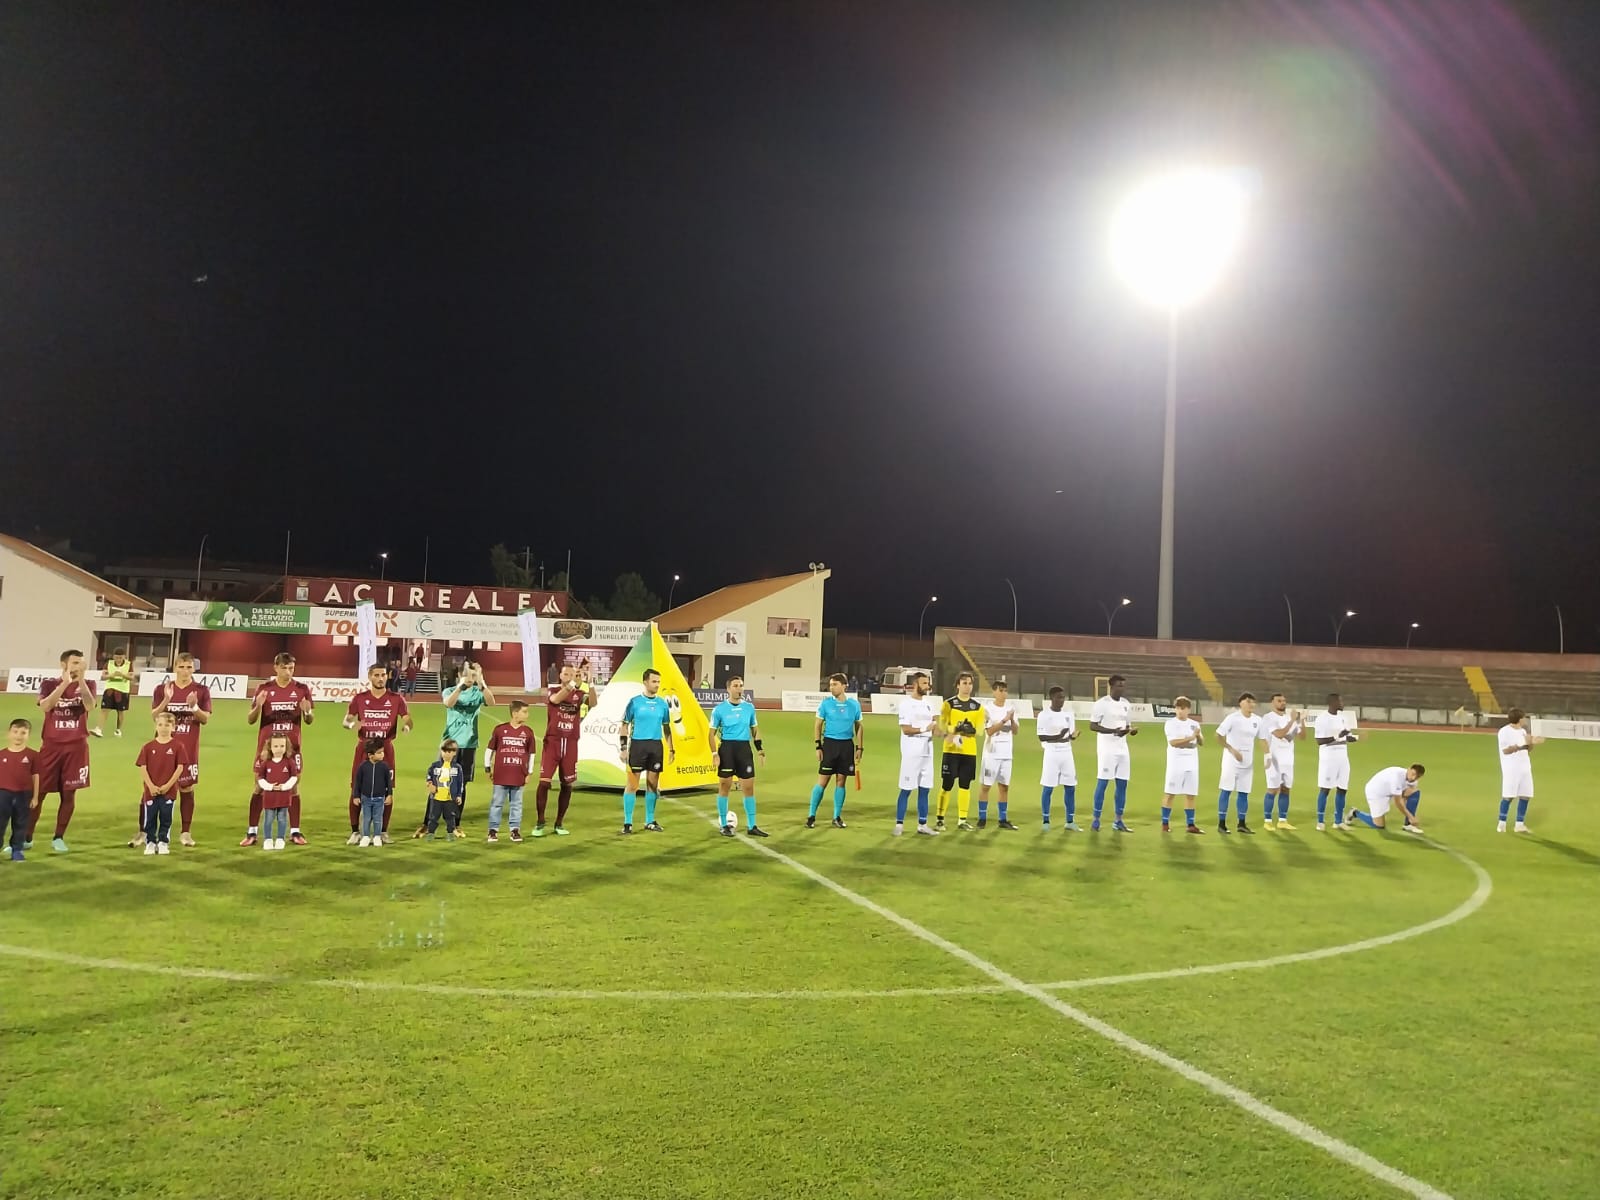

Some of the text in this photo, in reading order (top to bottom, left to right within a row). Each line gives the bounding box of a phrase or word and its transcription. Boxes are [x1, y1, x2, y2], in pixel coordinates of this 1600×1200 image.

[323, 583, 532, 610] ACIREALE
[325, 609, 380, 618] SUPERMTI
[324, 619, 392, 637] TOCL
[595, 625, 627, 633] INGROSSO
[161, 674, 237, 692] AMAR
[322, 687, 361, 698] TOCA
[693, 691, 752, 702] URIMPSA
